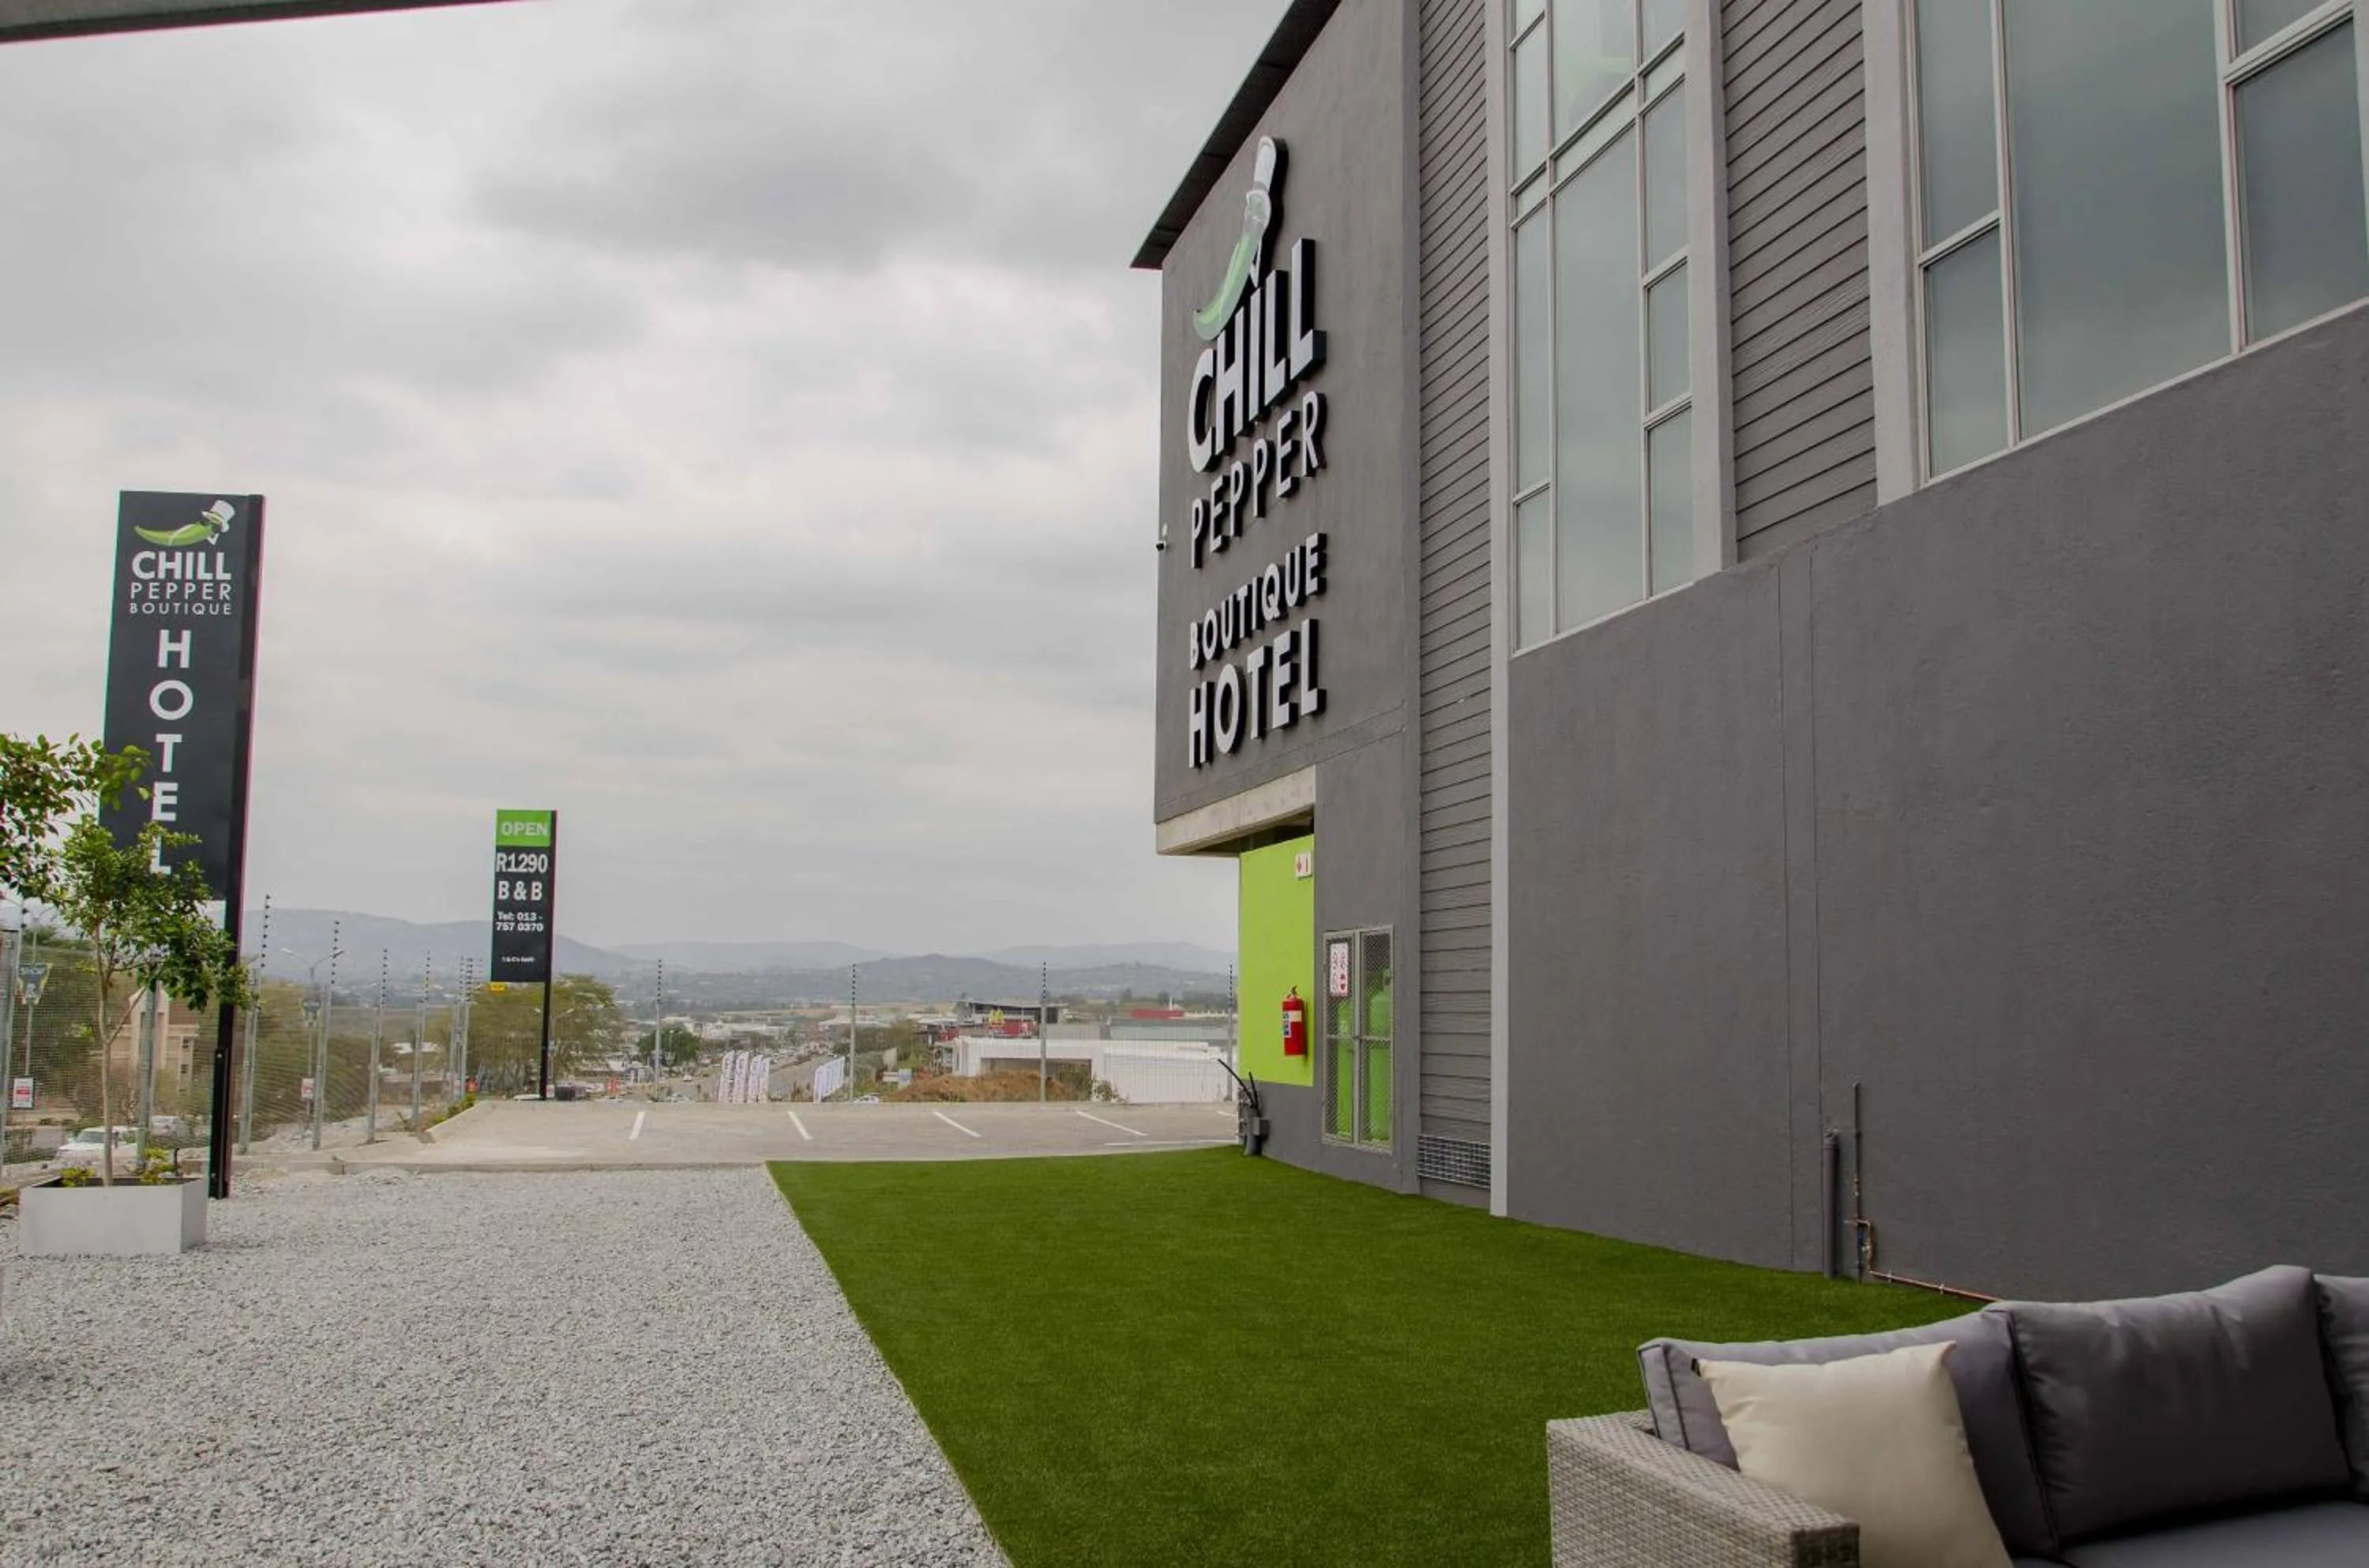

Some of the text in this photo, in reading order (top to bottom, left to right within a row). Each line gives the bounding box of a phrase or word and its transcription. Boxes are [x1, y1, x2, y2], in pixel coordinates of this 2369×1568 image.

[1188, 238, 1317, 473] CHILL
[1191, 392, 1320, 568] PEPPER
[132, 551, 231, 580] CHILL
[130, 583, 231, 599] PEPPER
[1189, 532, 1319, 670] BOUTIQUE
[130, 602, 231, 615] BOUTIQUE
[1188, 618, 1318, 768] HOTEL
[501, 821, 547, 836] OPEN
[496, 853, 549, 873] R1290
[497, 880, 543, 901] B & B
[496, 921, 515, 931] 757
[516, 912, 537, 921] 013
